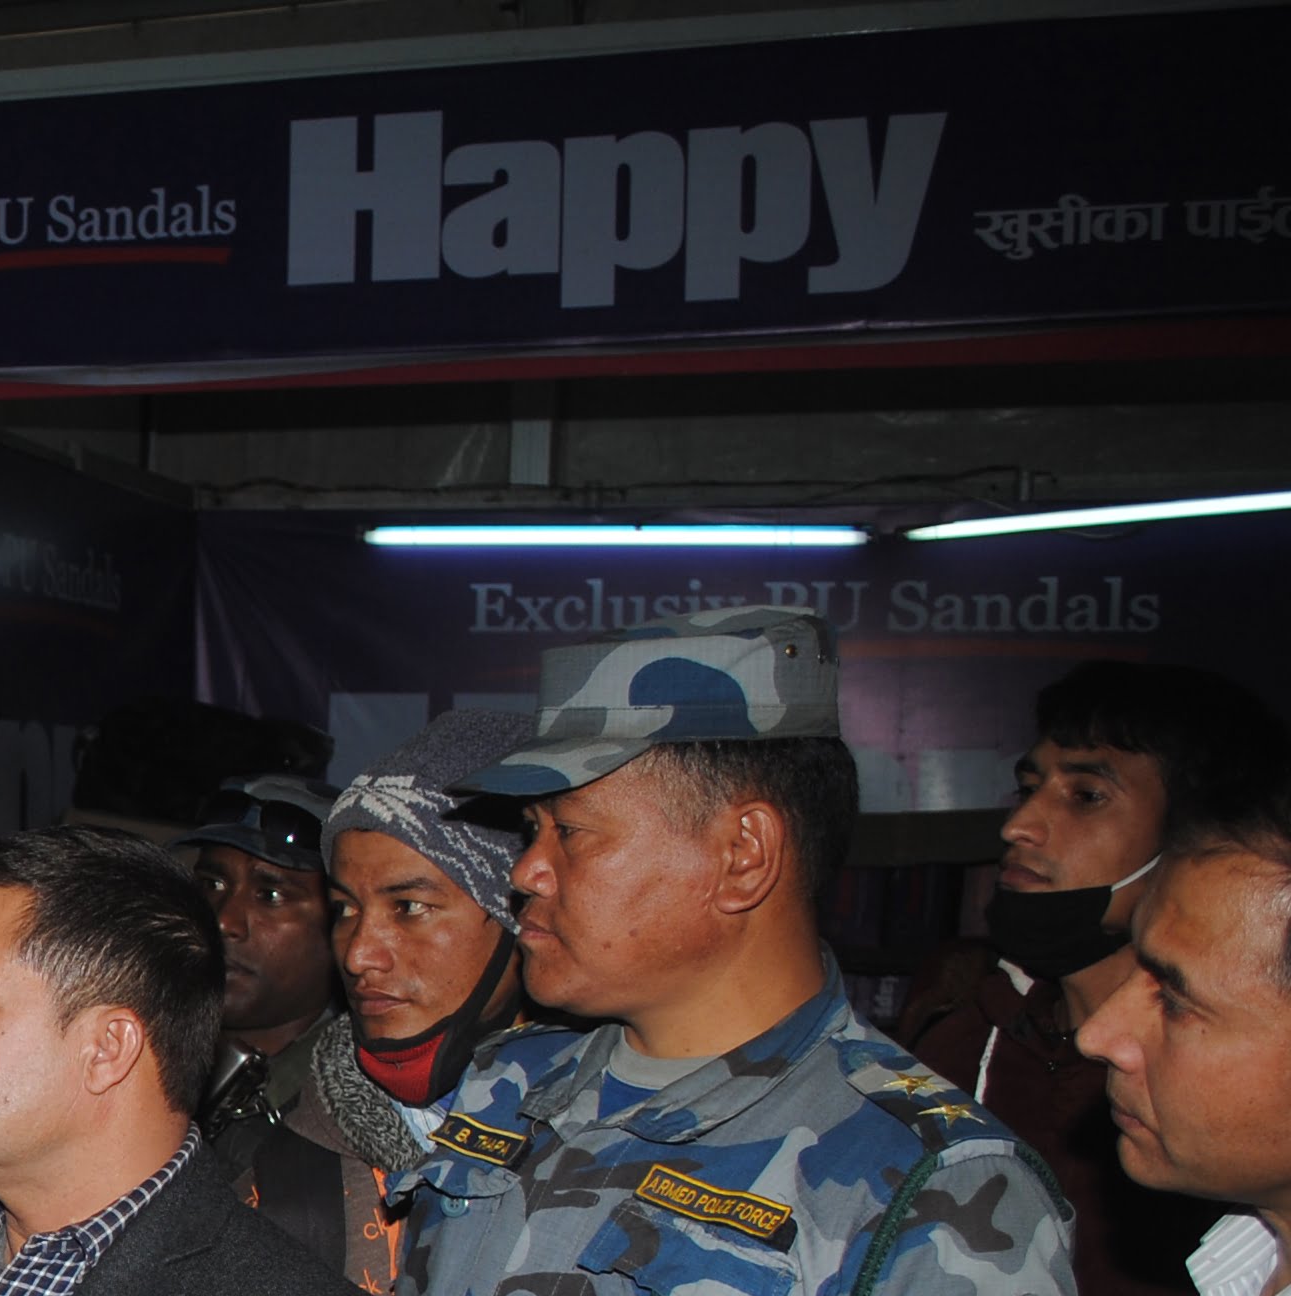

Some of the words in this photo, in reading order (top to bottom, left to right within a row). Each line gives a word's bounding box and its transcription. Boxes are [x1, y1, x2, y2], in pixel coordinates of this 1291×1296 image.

[46, 185, 237, 244] Sandals
[287, 110, 948, 310] Happy
[888, 574, 1161, 634] Sandals
[647, 1175, 698, 1206] ARMED
[731, 1202, 782, 1230] FORCE
